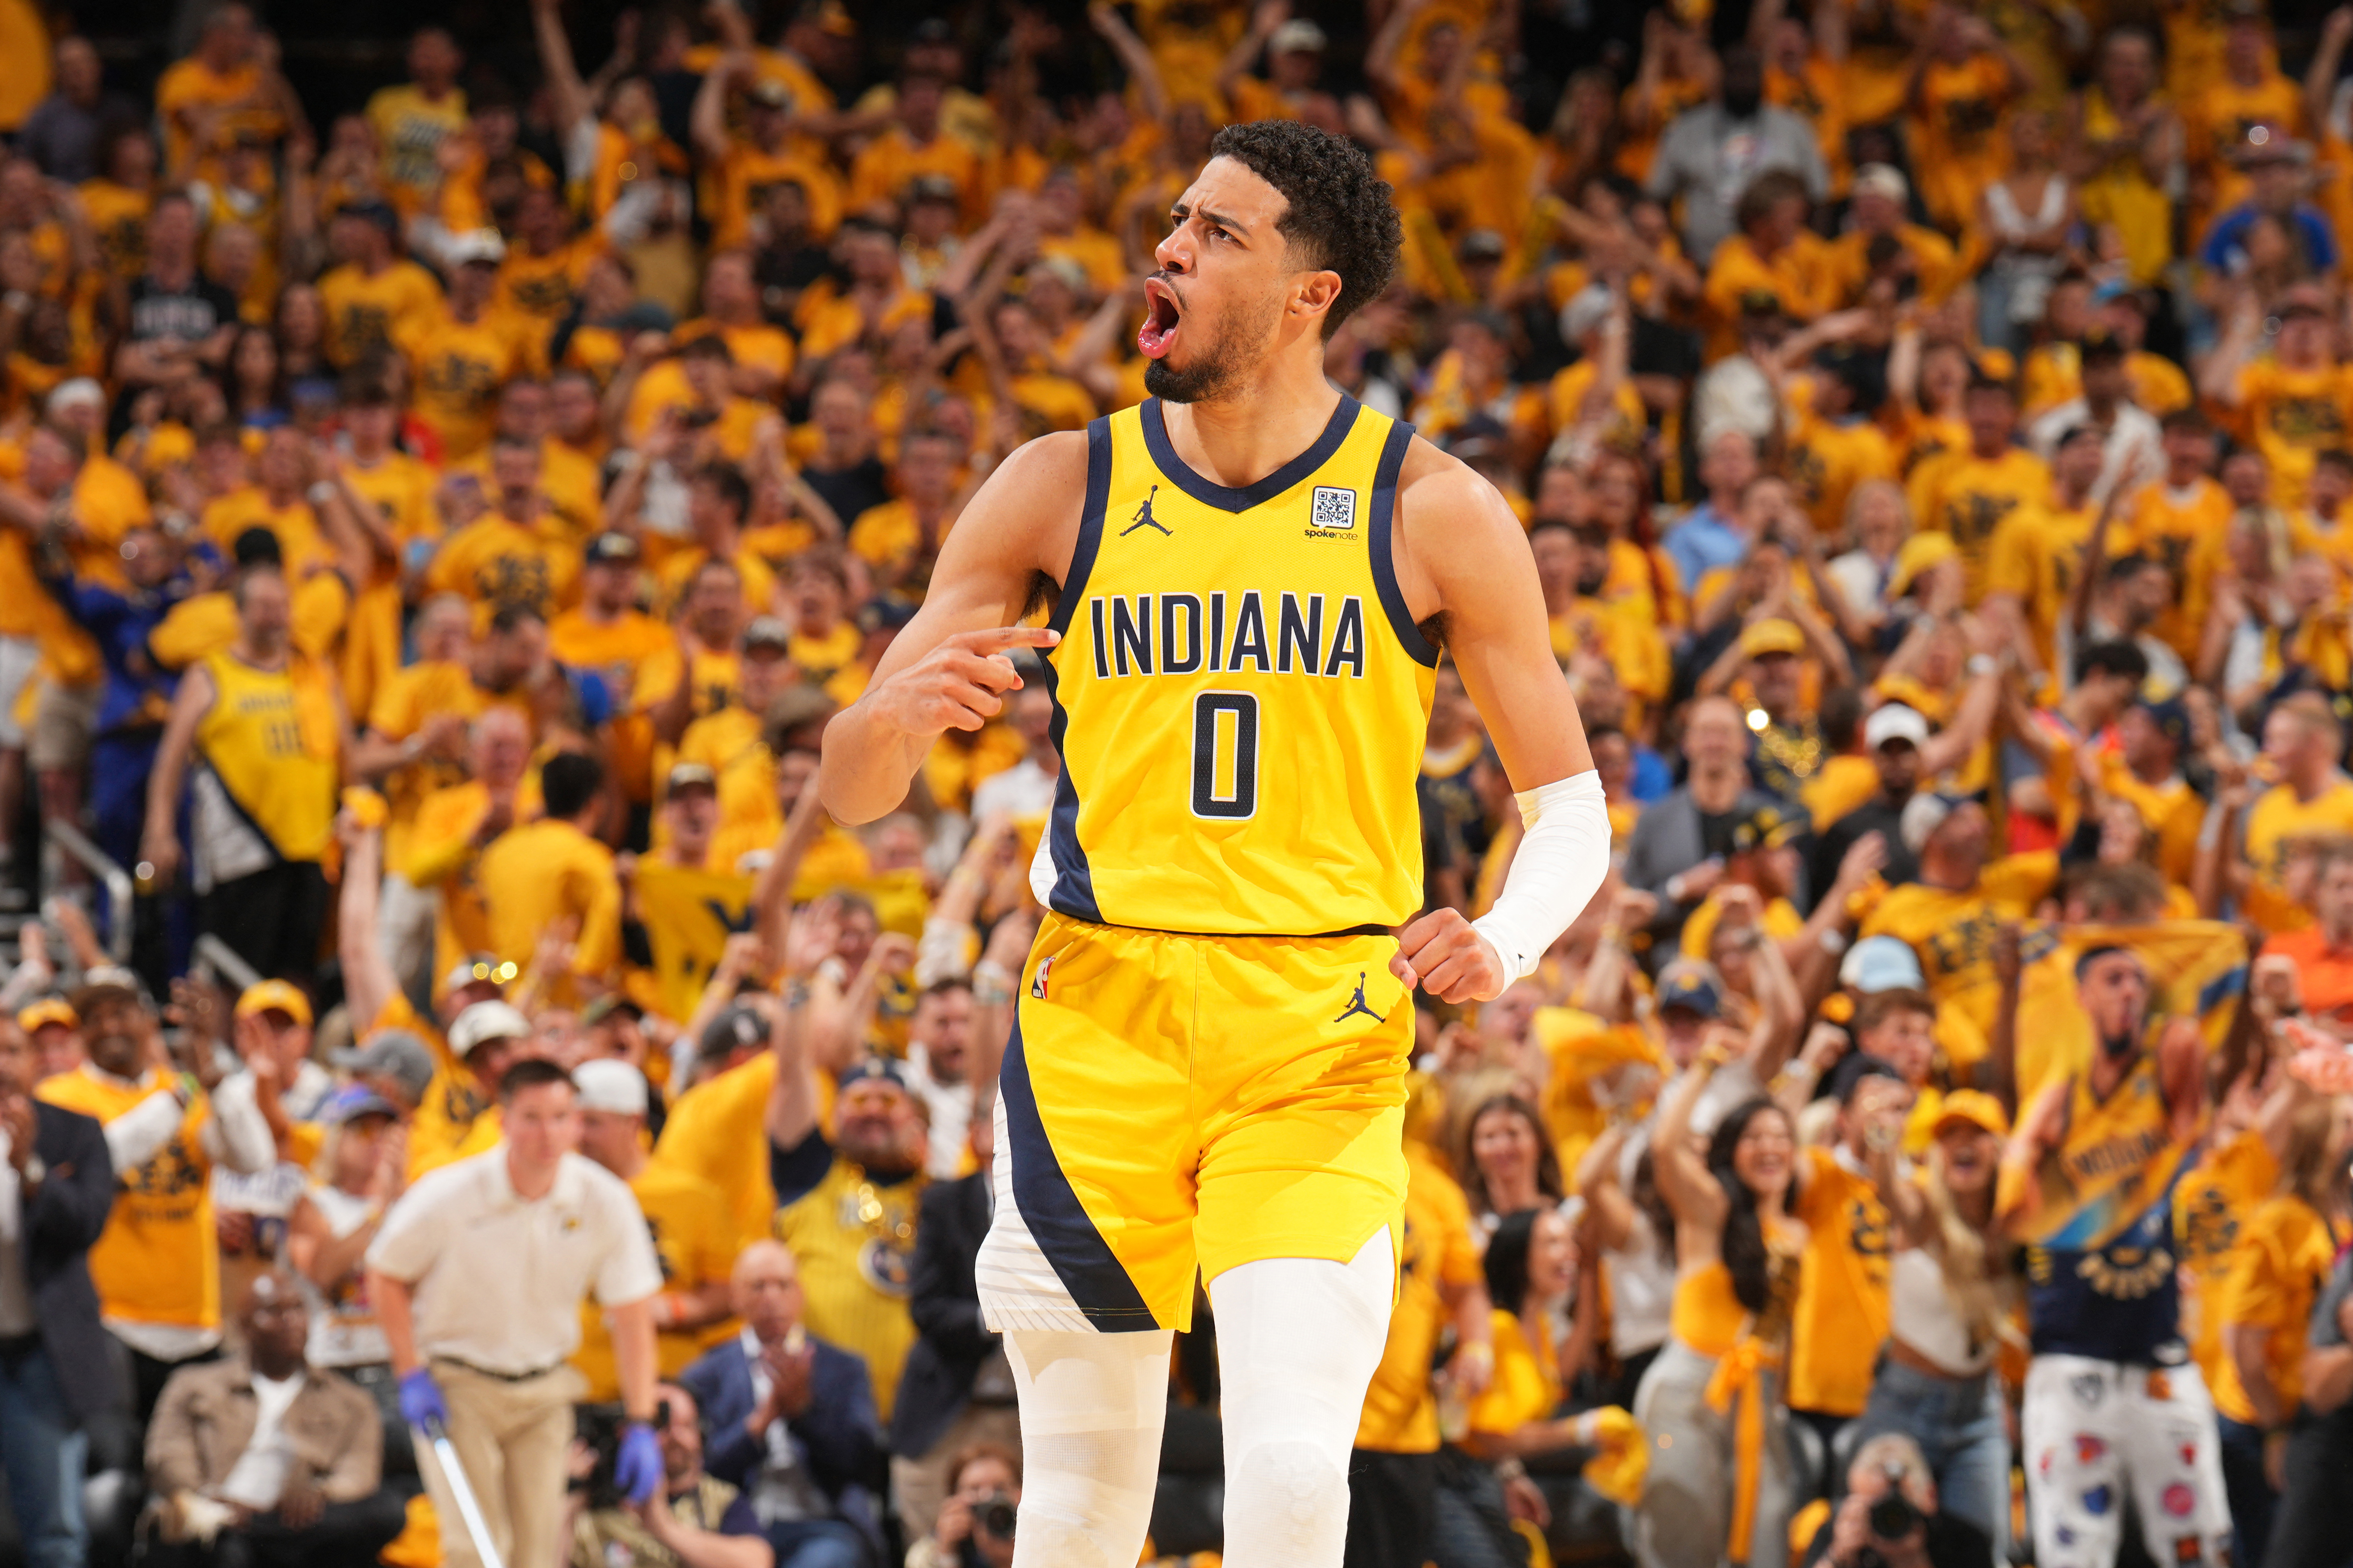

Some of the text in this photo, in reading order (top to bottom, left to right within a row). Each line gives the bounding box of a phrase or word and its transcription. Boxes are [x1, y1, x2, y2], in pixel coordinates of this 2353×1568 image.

[1305, 529, 1358, 540] spokenote
[1089, 589, 1365, 680] INDIANA
[1189, 689, 1260, 821] 0
[1032, 988, 1042, 998] NBA
